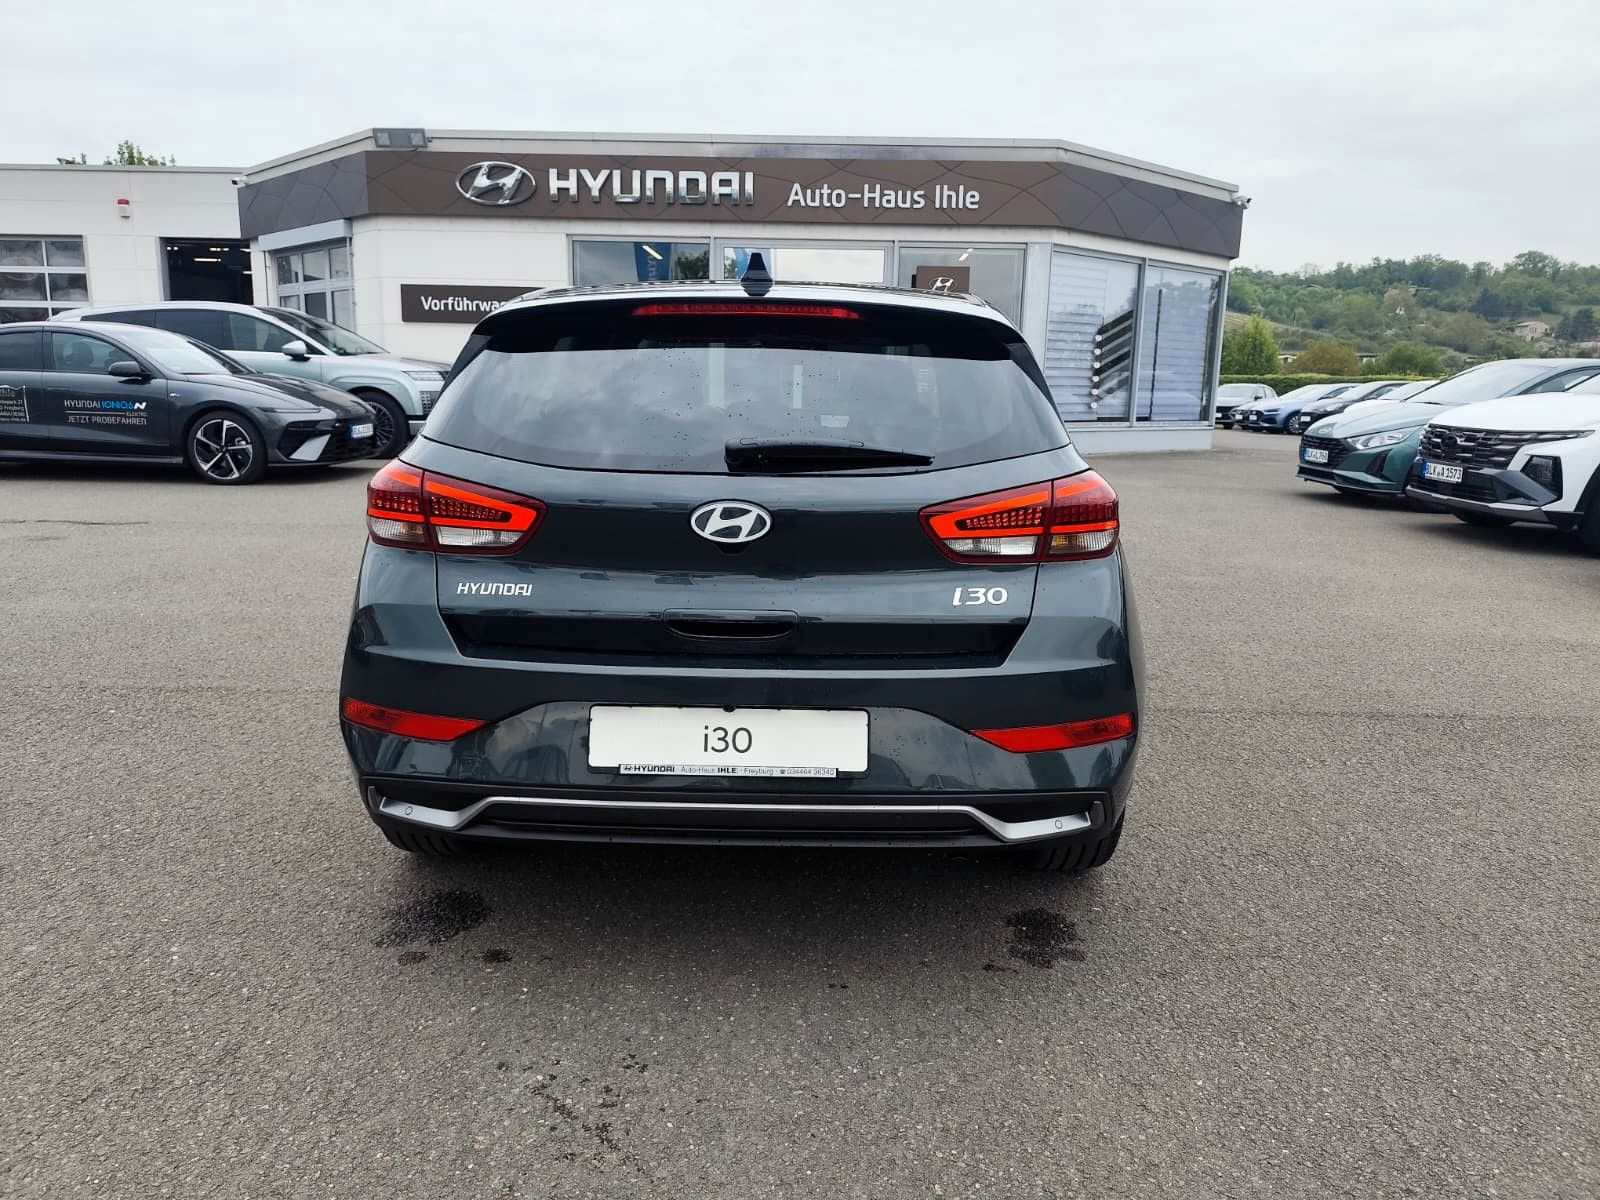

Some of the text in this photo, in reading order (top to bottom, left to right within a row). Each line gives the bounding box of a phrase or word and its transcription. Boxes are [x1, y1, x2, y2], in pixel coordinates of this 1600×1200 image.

[549, 168, 754, 206] HYUNDAI
[787, 182, 981, 210] Auto-Haus Ihle
[64, 399, 101, 409] HYUNDAI
[67, 415, 147, 425] JETZT PROBEFAHREN
[456, 582, 533, 597] HYUNDAI
[952, 587, 1008, 606] i30
[703, 725, 752, 754] i30
[633, 765, 675, 773] HYUNDAI
